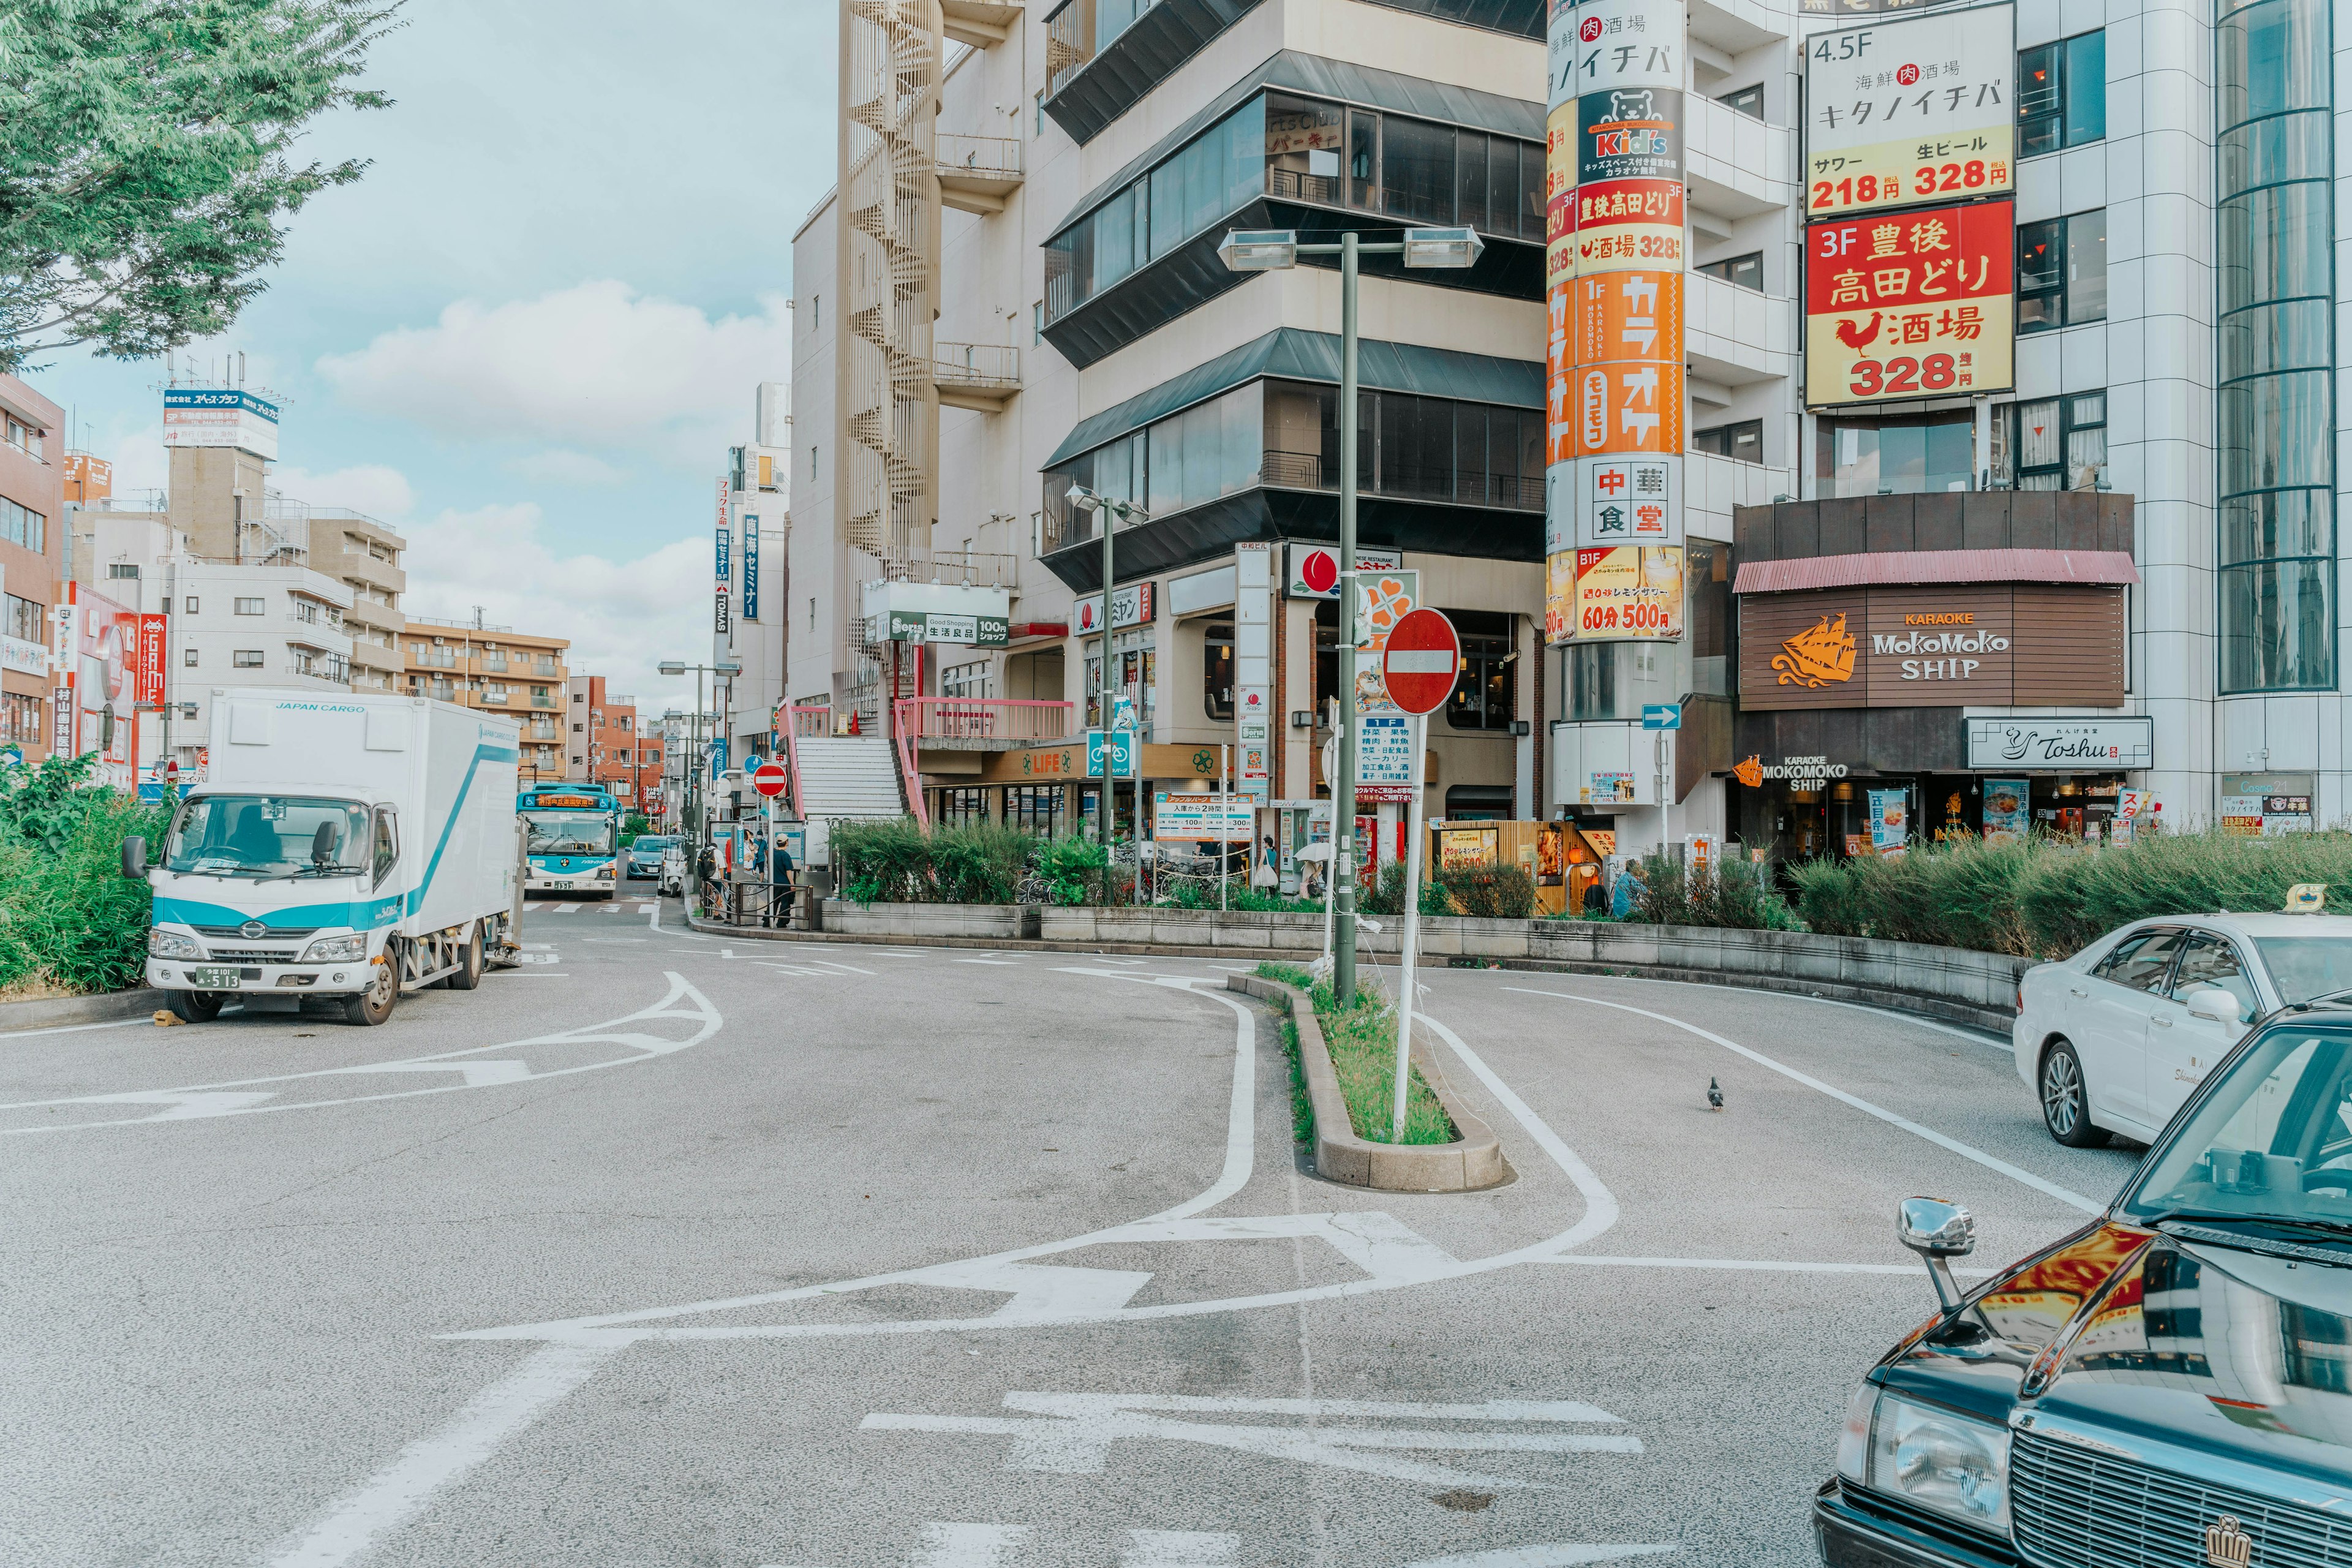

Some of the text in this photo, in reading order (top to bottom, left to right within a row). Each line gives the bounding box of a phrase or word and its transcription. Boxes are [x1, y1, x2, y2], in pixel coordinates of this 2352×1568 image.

[1562, 1, 1570, 12] 6F
[1814, 32, 1872, 62] 4.5F
[1855, 60, 1960, 91] 海鮮肉酒場
[1819, 79, 2001, 129] キタノイチバ
[1596, 127, 1667, 158] Kid's
[1917, 136, 1988, 160] 生ビール
[1605, 167, 1657, 177] カラオケ無料
[1814, 157, 1863, 174] サワー
[1915, 160, 1986, 195] 328
[1991, 167, 2006, 186] 円
[1563, 192, 1575, 208] 3F
[1669, 185, 1682, 197] 3F
[1812, 175, 1878, 209] 218
[1884, 183, 1899, 200] 円
[1580, 190, 1670, 224] 豊後高田どり
[1595, 235, 1635, 259] 酒場
[1640, 235, 1675, 258] 328
[1820, 227, 1857, 258] 3F
[1866, 219, 1951, 261] 豊後
[1550, 247, 1569, 274] 328
[1585, 279, 1605, 300] 1F
[1830, 255, 1989, 306] 高田どり
[1887, 306, 1985, 345] 酒場
[1621, 276, 1660, 447] カラオケ
[1549, 290, 1569, 458] カラオケ
[1850, 353, 1956, 396] 328
[1959, 373, 1972, 386] 円
[193, 393, 239, 404] スペース・プラン
[1589, 376, 1602, 443] モコモコ
[88, 458, 111, 476] トーア
[1599, 468, 1662, 496] 中華
[718, 480, 728, 525] フコク生命
[1599, 505, 1662, 533] 食堂
[717, 530, 728, 573] 臨海セミナー
[1580, 552, 1600, 565] B1F
[745, 518, 756, 616] 臨海セミナー
[1115, 591, 1133, 601] RESTAURANT
[1142, 587, 1148, 617] 2F
[717, 597, 726, 631] TOMAS
[1583, 603, 1668, 630] 60分 500円
[1905, 613, 1974, 625] KARAOKE
[930, 627, 973, 638] 生活良品
[980, 621, 1006, 633] 100円
[1901, 658, 1980, 680] SHIP
[320, 704, 365, 713] CARGO
[1359, 701, 1399, 710] スーパーマー
[57, 689, 70, 761] 村山歯科医院
[1785, 756, 1828, 765] KARAOKE
[2037, 737, 2108, 760] Toshu
[1033, 753, 1060, 774] LIFE
[1763, 764, 1849, 779] MOKOMOKO
[1790, 778, 1827, 792] SHIP
[2241, 780, 2287, 793] Cosmo 21
[2123, 793, 2137, 818] スタ
